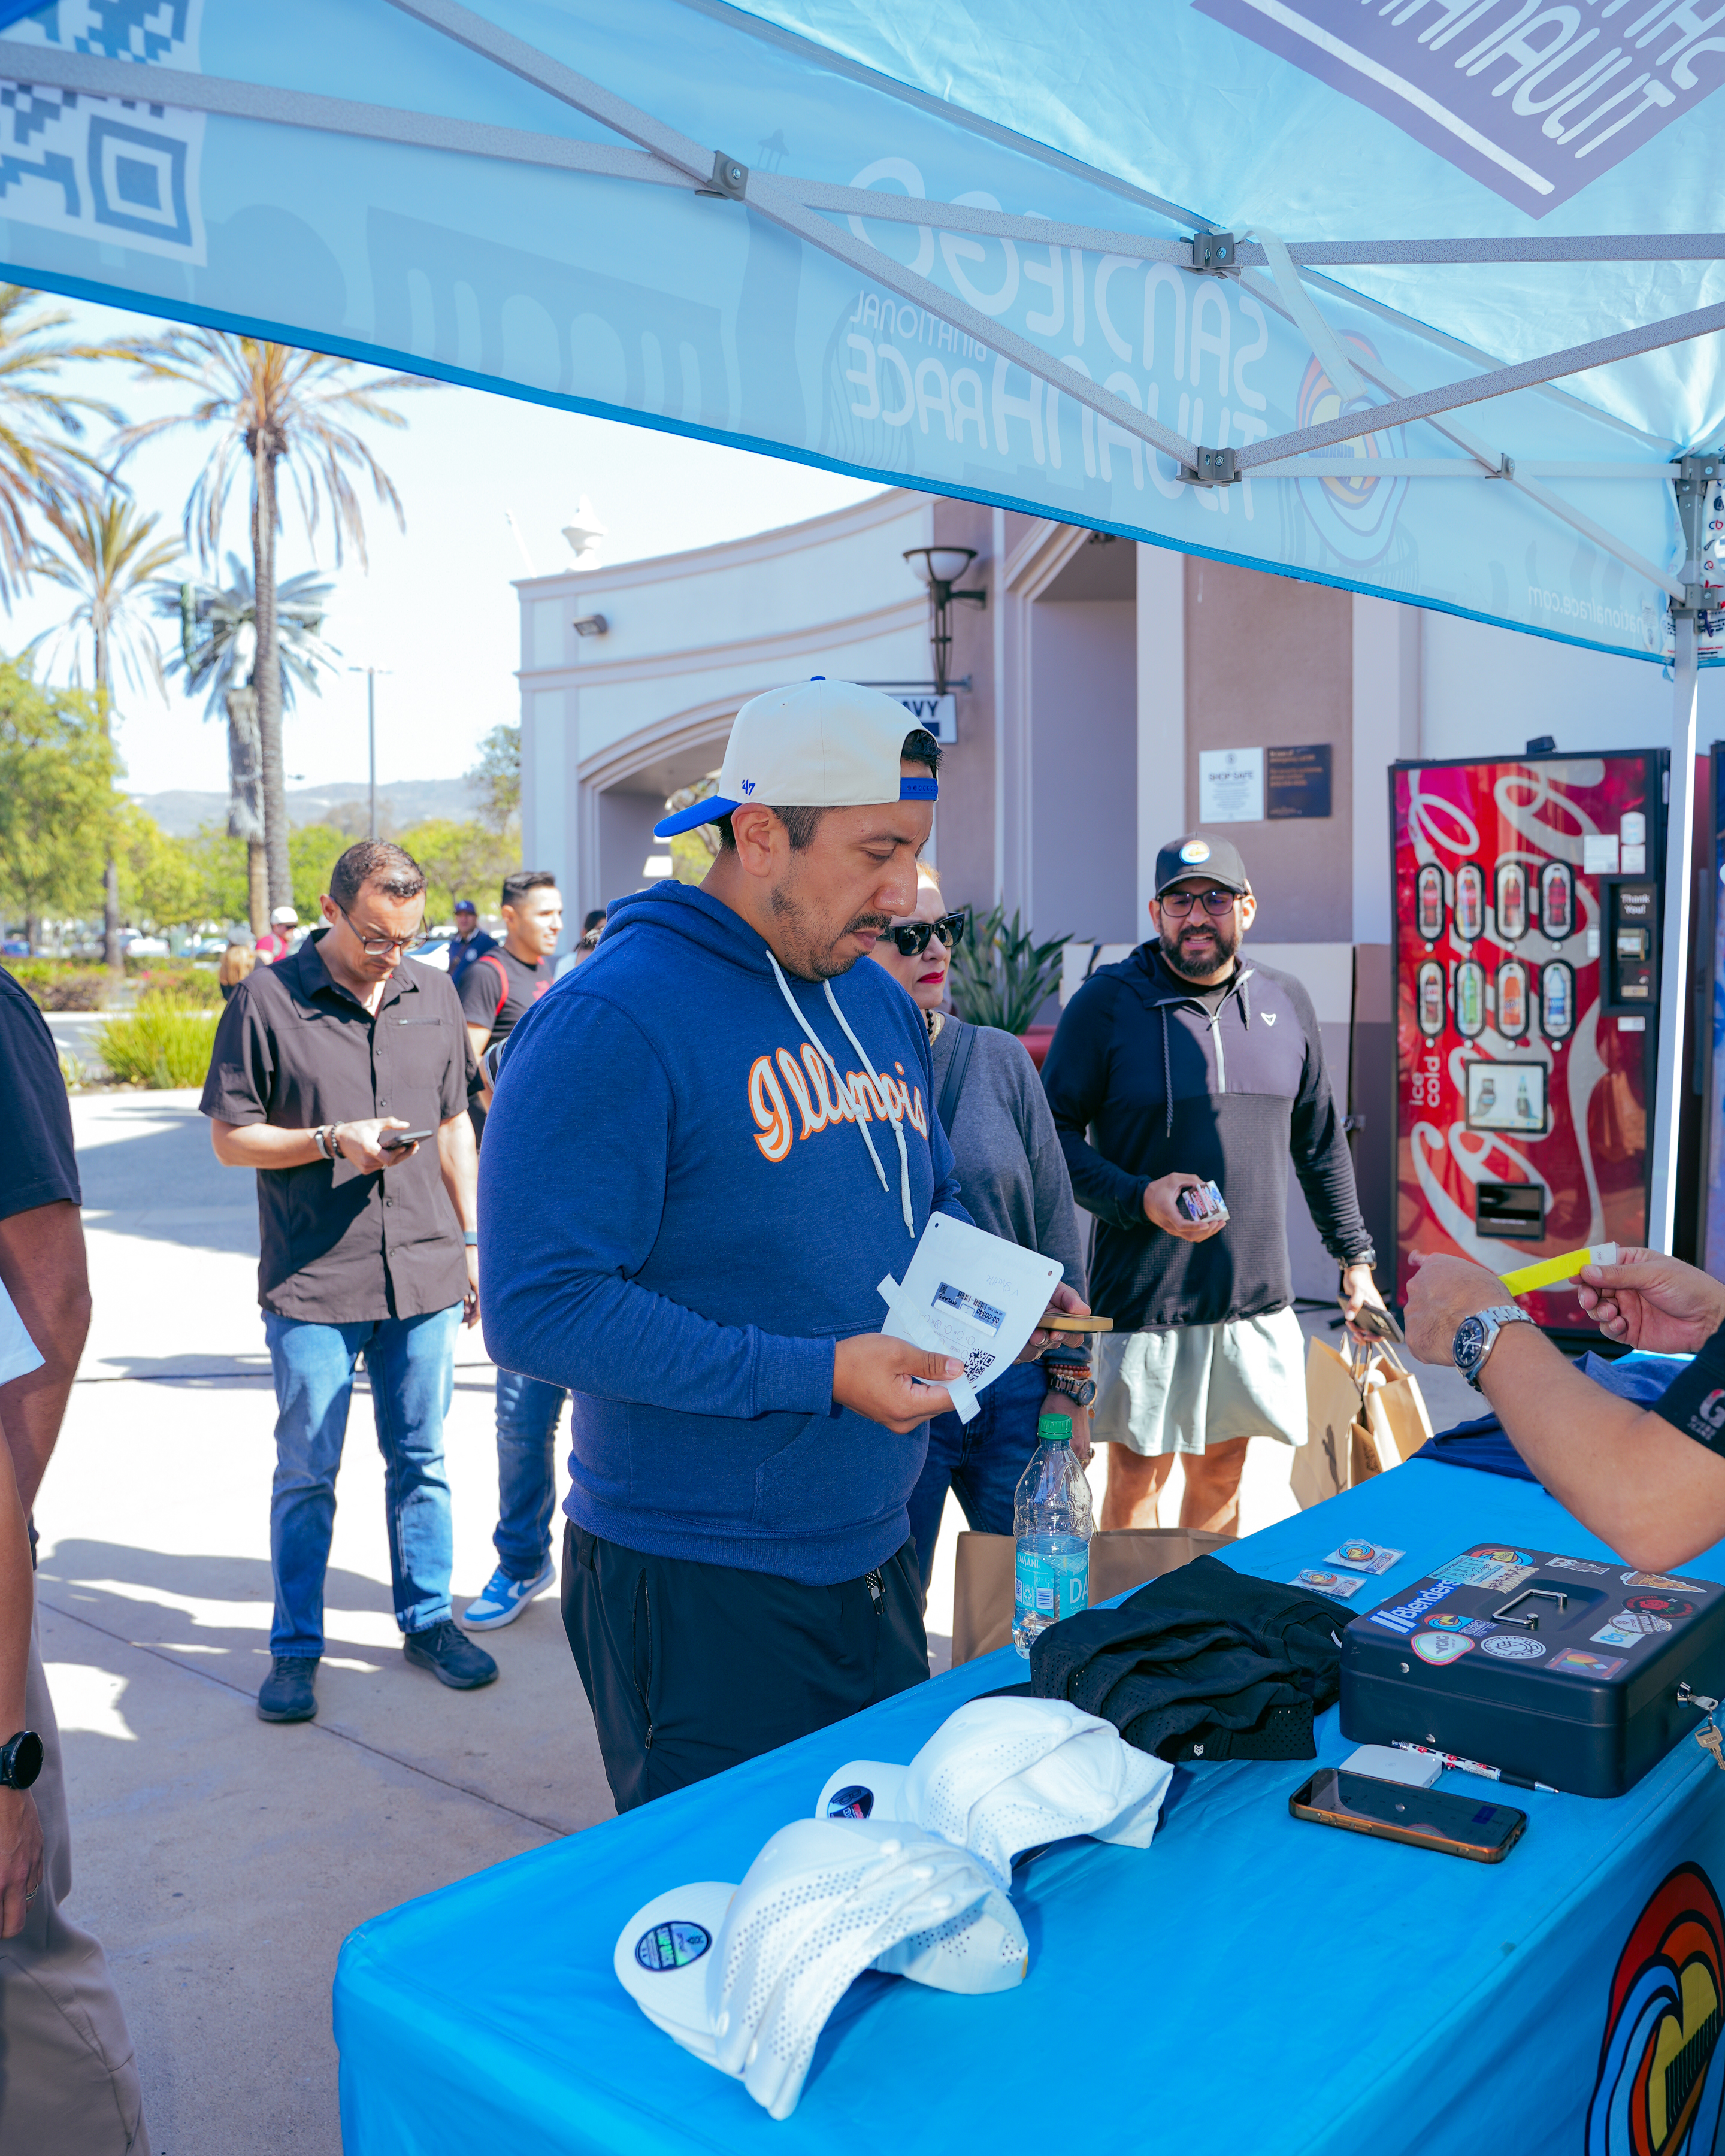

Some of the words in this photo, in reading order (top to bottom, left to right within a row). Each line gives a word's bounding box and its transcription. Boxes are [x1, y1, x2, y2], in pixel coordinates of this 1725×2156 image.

[1621, 894, 1650, 904] Thank
[1624, 904, 1646, 914] You!
[1424, 1056, 1440, 1107] cold
[939, 1294, 957, 1306] MYLAPS
[976, 1308, 1000, 1324] 00-00340
[1018, 1553, 1039, 1568] DASANI
[1391, 1580, 1461, 1619] Blenders
